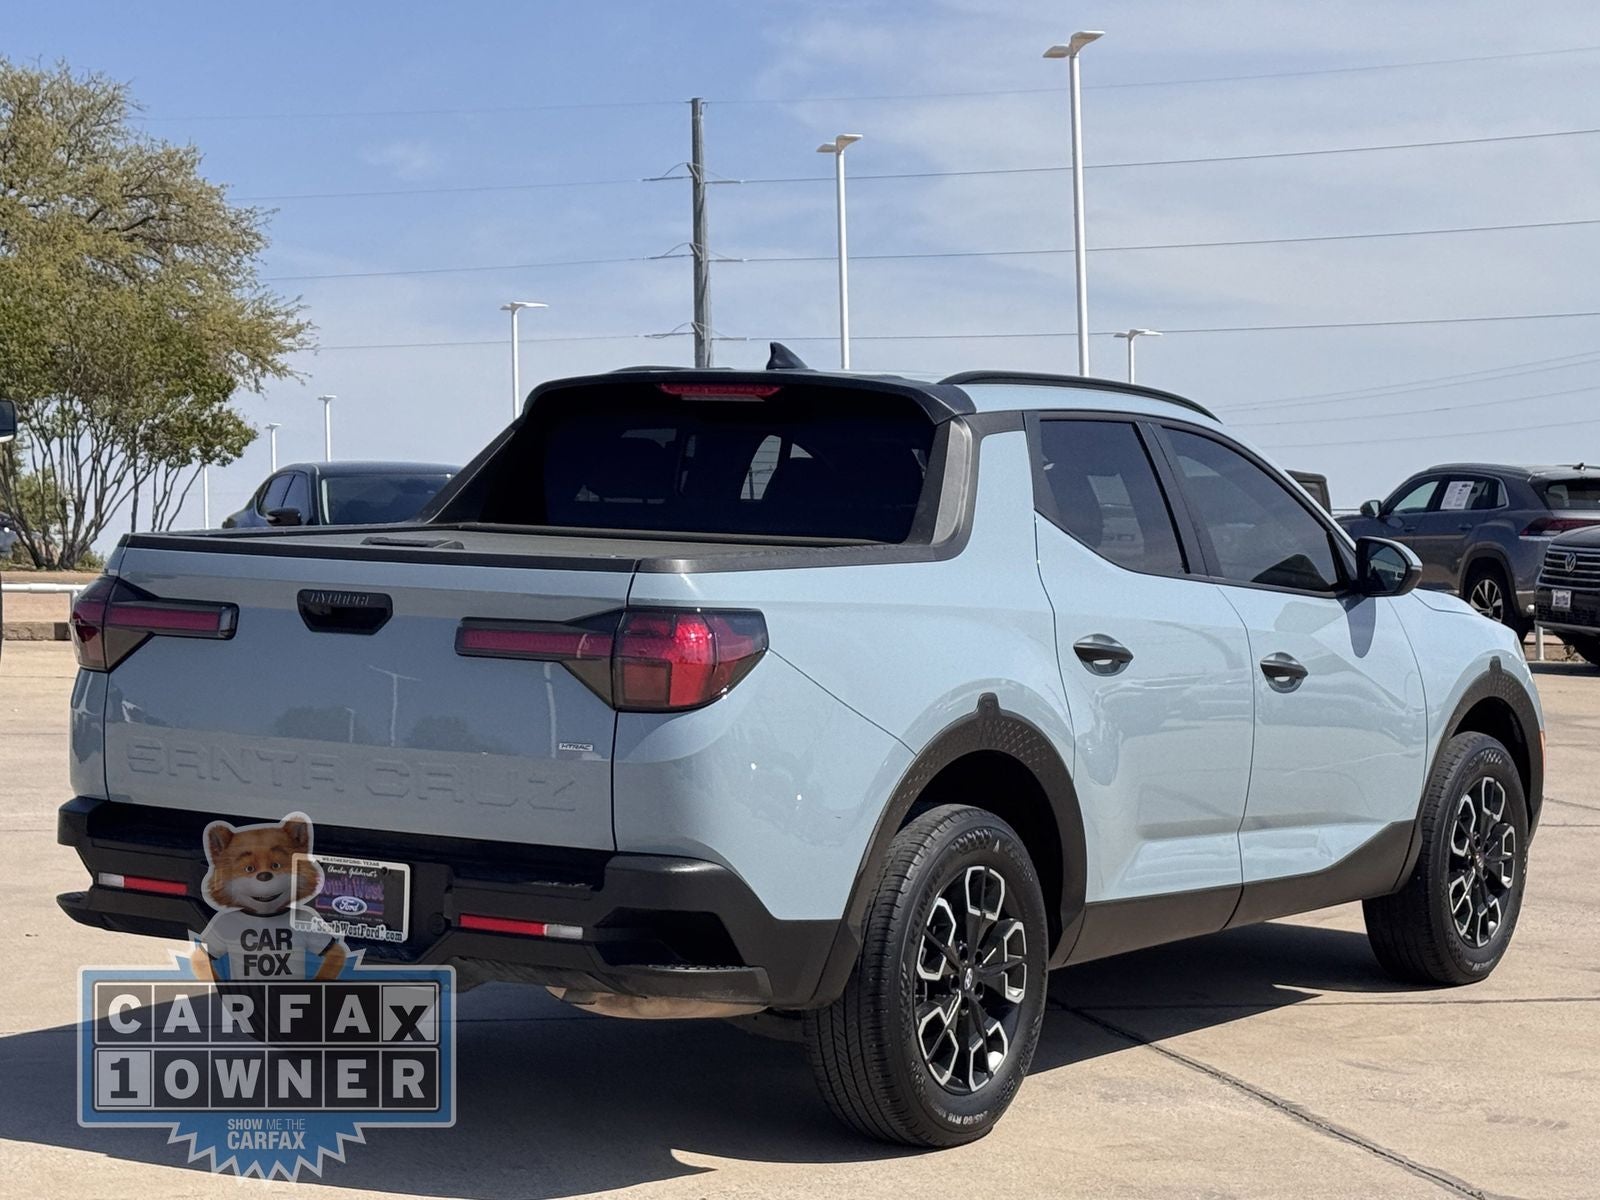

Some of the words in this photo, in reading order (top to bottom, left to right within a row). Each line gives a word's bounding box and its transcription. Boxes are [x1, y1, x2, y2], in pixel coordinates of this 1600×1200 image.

[125, 736, 345, 793] SANTA
[365, 759, 577, 812] CRUZ
[339, 898, 360, 912] Ford
